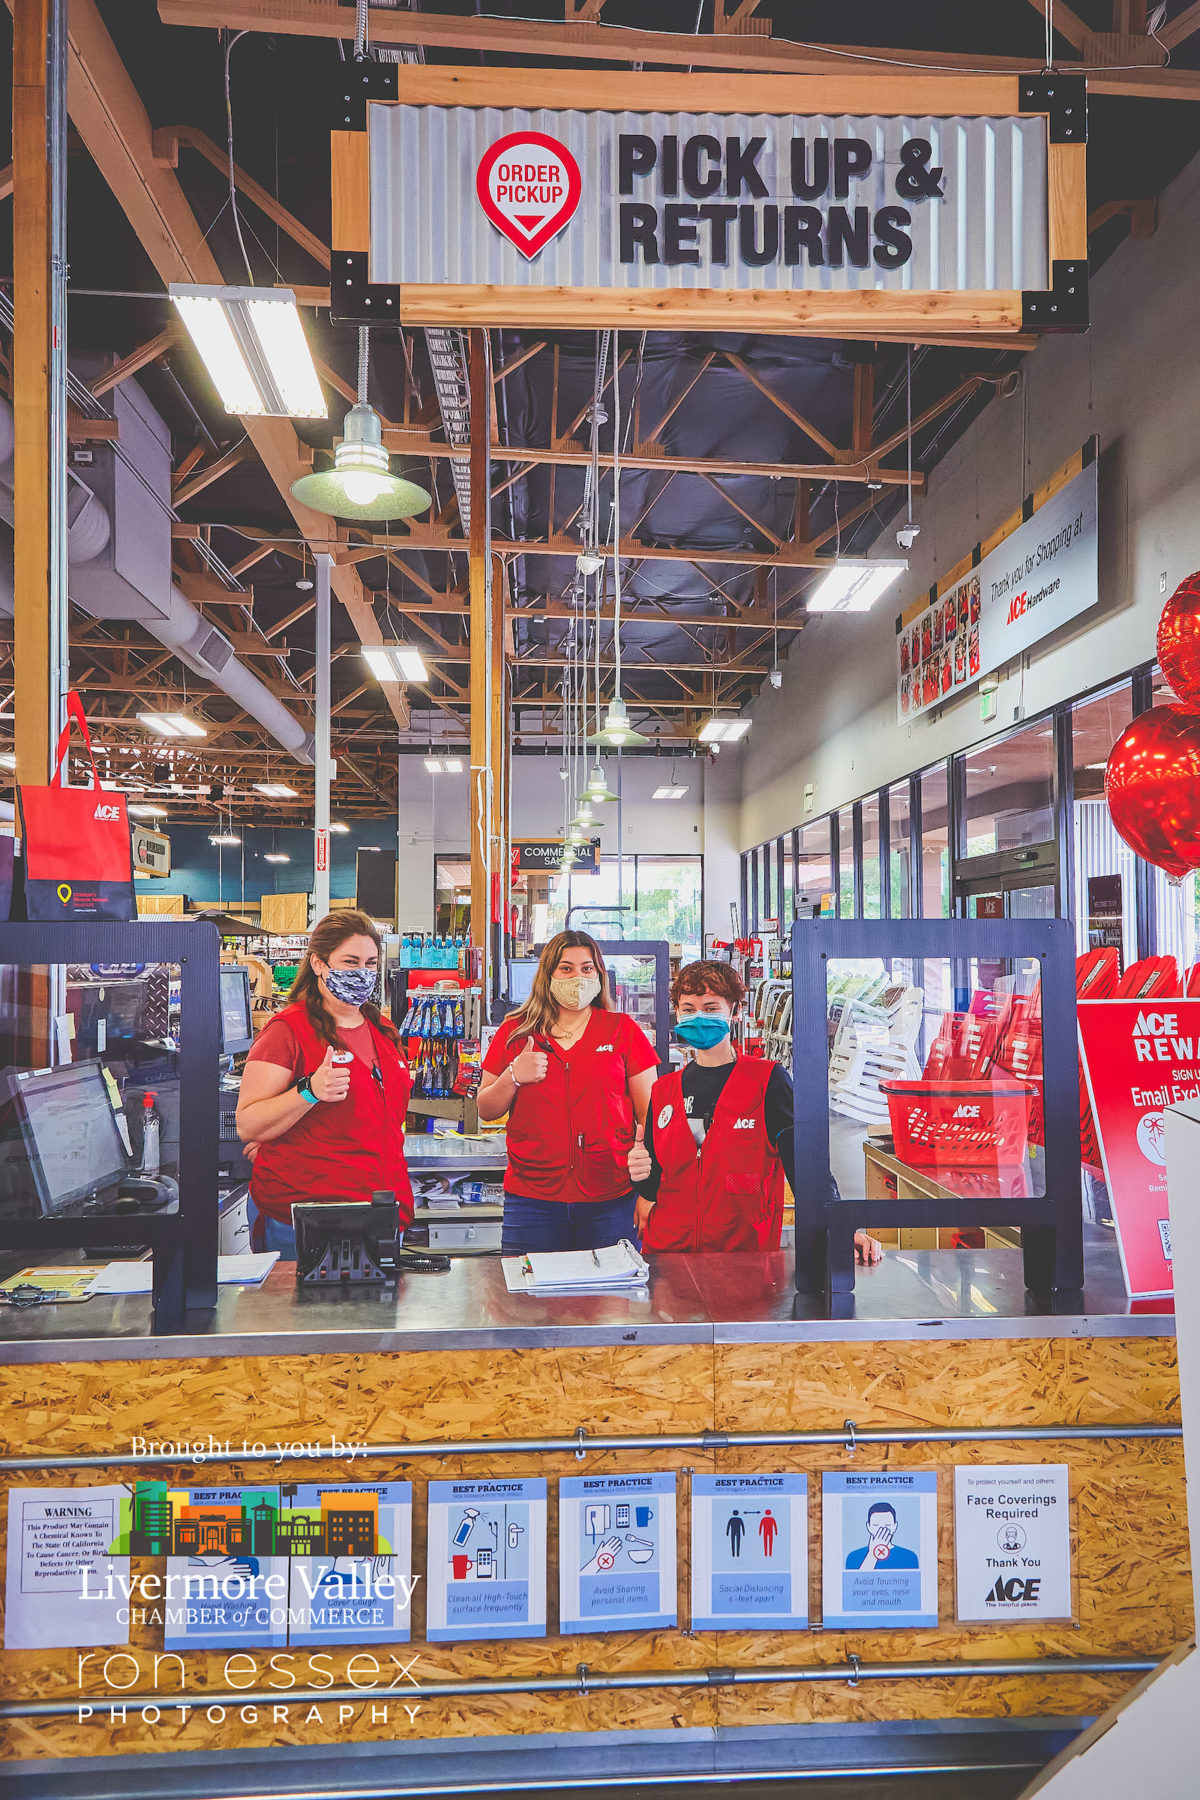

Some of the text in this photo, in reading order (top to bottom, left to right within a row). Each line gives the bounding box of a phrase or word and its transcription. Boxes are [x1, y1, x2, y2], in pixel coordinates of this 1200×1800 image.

[498, 164, 560, 182] ORDER
[618, 134, 945, 201] PICK UP &
[496, 185, 563, 203] PICKUP
[619, 202, 913, 269] RETURNS
[991, 510, 1083, 602] Thank you for Shopping at
[1006, 577, 1061, 626] ACE Hardware
[94, 803, 120, 819] ACE
[524, 847, 592, 857] COMMECIAL
[1132, 1010, 1178, 1036] ACE
[596, 1044, 614, 1052] ACE
[1172, 1069, 1193, 1081] SIGN
[1131, 1083, 1200, 1107] Email Excl
[952, 1104, 980, 1118] ACE
[733, 1118, 756, 1129] ACE
[1149, 1184, 1168, 1192] Remi
[583, 1478, 653, 1488] BEST PRACTICE
[715, 1478, 784, 1487] BEST PRACTICE
[870, 1476, 914, 1484] PRACTICE
[976, 1479, 997, 1487] protect
[998, 1478, 1022, 1486] yourself
[452, 1483, 523, 1493] BEST PRACTICE
[193, 1492, 216, 1500] BEST
[967, 1494, 1057, 1507] Face Coverings
[45, 1507, 92, 1517] WARNING
[986, 1508, 1038, 1521] Required
[70, 1522, 83, 1530] May
[39, 1531, 69, 1539] Chemical
[45, 1541, 61, 1549] State
[71, 1540, 104, 1548] California
[985, 1557, 1041, 1568] Thank You
[34, 1568, 77, 1578] Reproductive
[854, 1577, 909, 1587] Avoid Touching
[985, 1574, 1041, 1601] ACE
[593, 1584, 646, 1596] Avoid Sharing
[719, 1584, 784, 1595] Social Distancing
[852, 1589, 870, 1597] your
[892, 1588, 911, 1596] nose
[328, 1597, 378, 1608] Cover Cough
[447, 1592, 528, 1603] Clean all High-Touch
[591, 1594, 648, 1606] personal items
[754, 1595, 775, 1604] apart
[861, 1597, 902, 1606] and mouth
[223, 1601, 257, 1610] Washing
[452, 1602, 524, 1614] surface frequently
